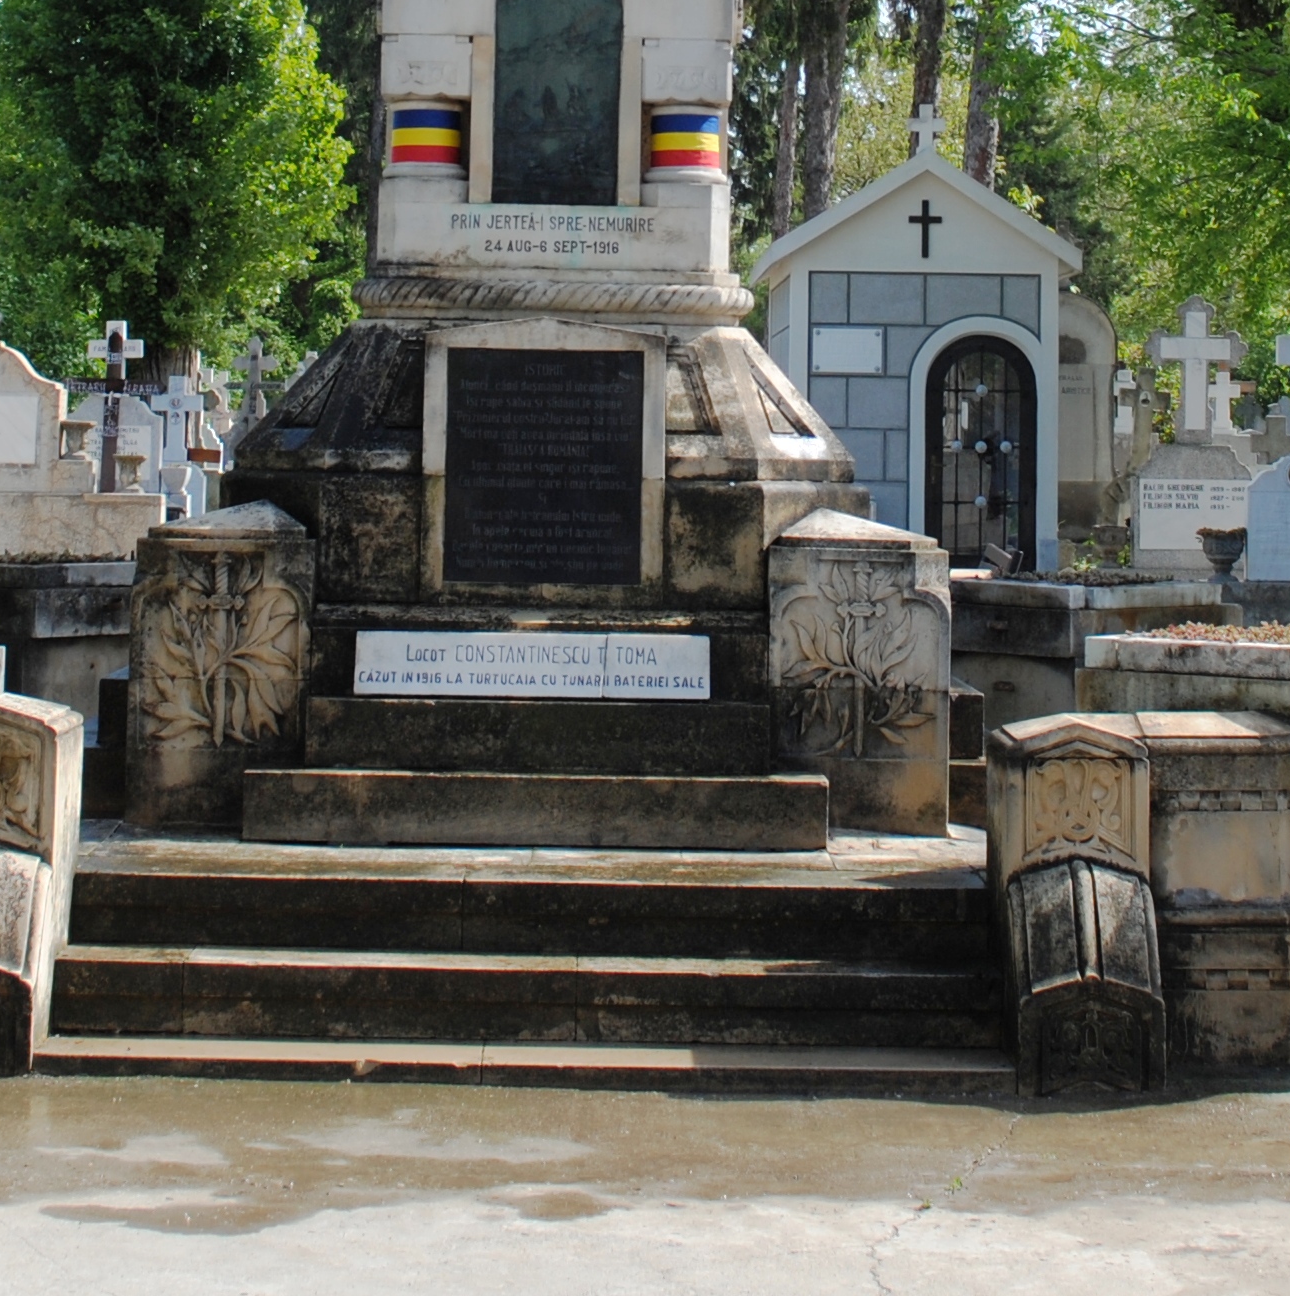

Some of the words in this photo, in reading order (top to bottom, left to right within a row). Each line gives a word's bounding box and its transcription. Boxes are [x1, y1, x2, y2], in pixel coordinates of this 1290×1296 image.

[451, 212, 481, 230] PRIN
[483, 239, 503, 253] 24
[455, 643, 591, 665] CONSTANTINESCU
[616, 646, 658, 666] TOMA
[446, 672, 463, 685] LA
[468, 672, 536, 686] TURTUCAIA
[541, 673, 557, 686] CU
[614, 674, 669, 688] BATERIEI
[672, 675, 705, 689] SALE
